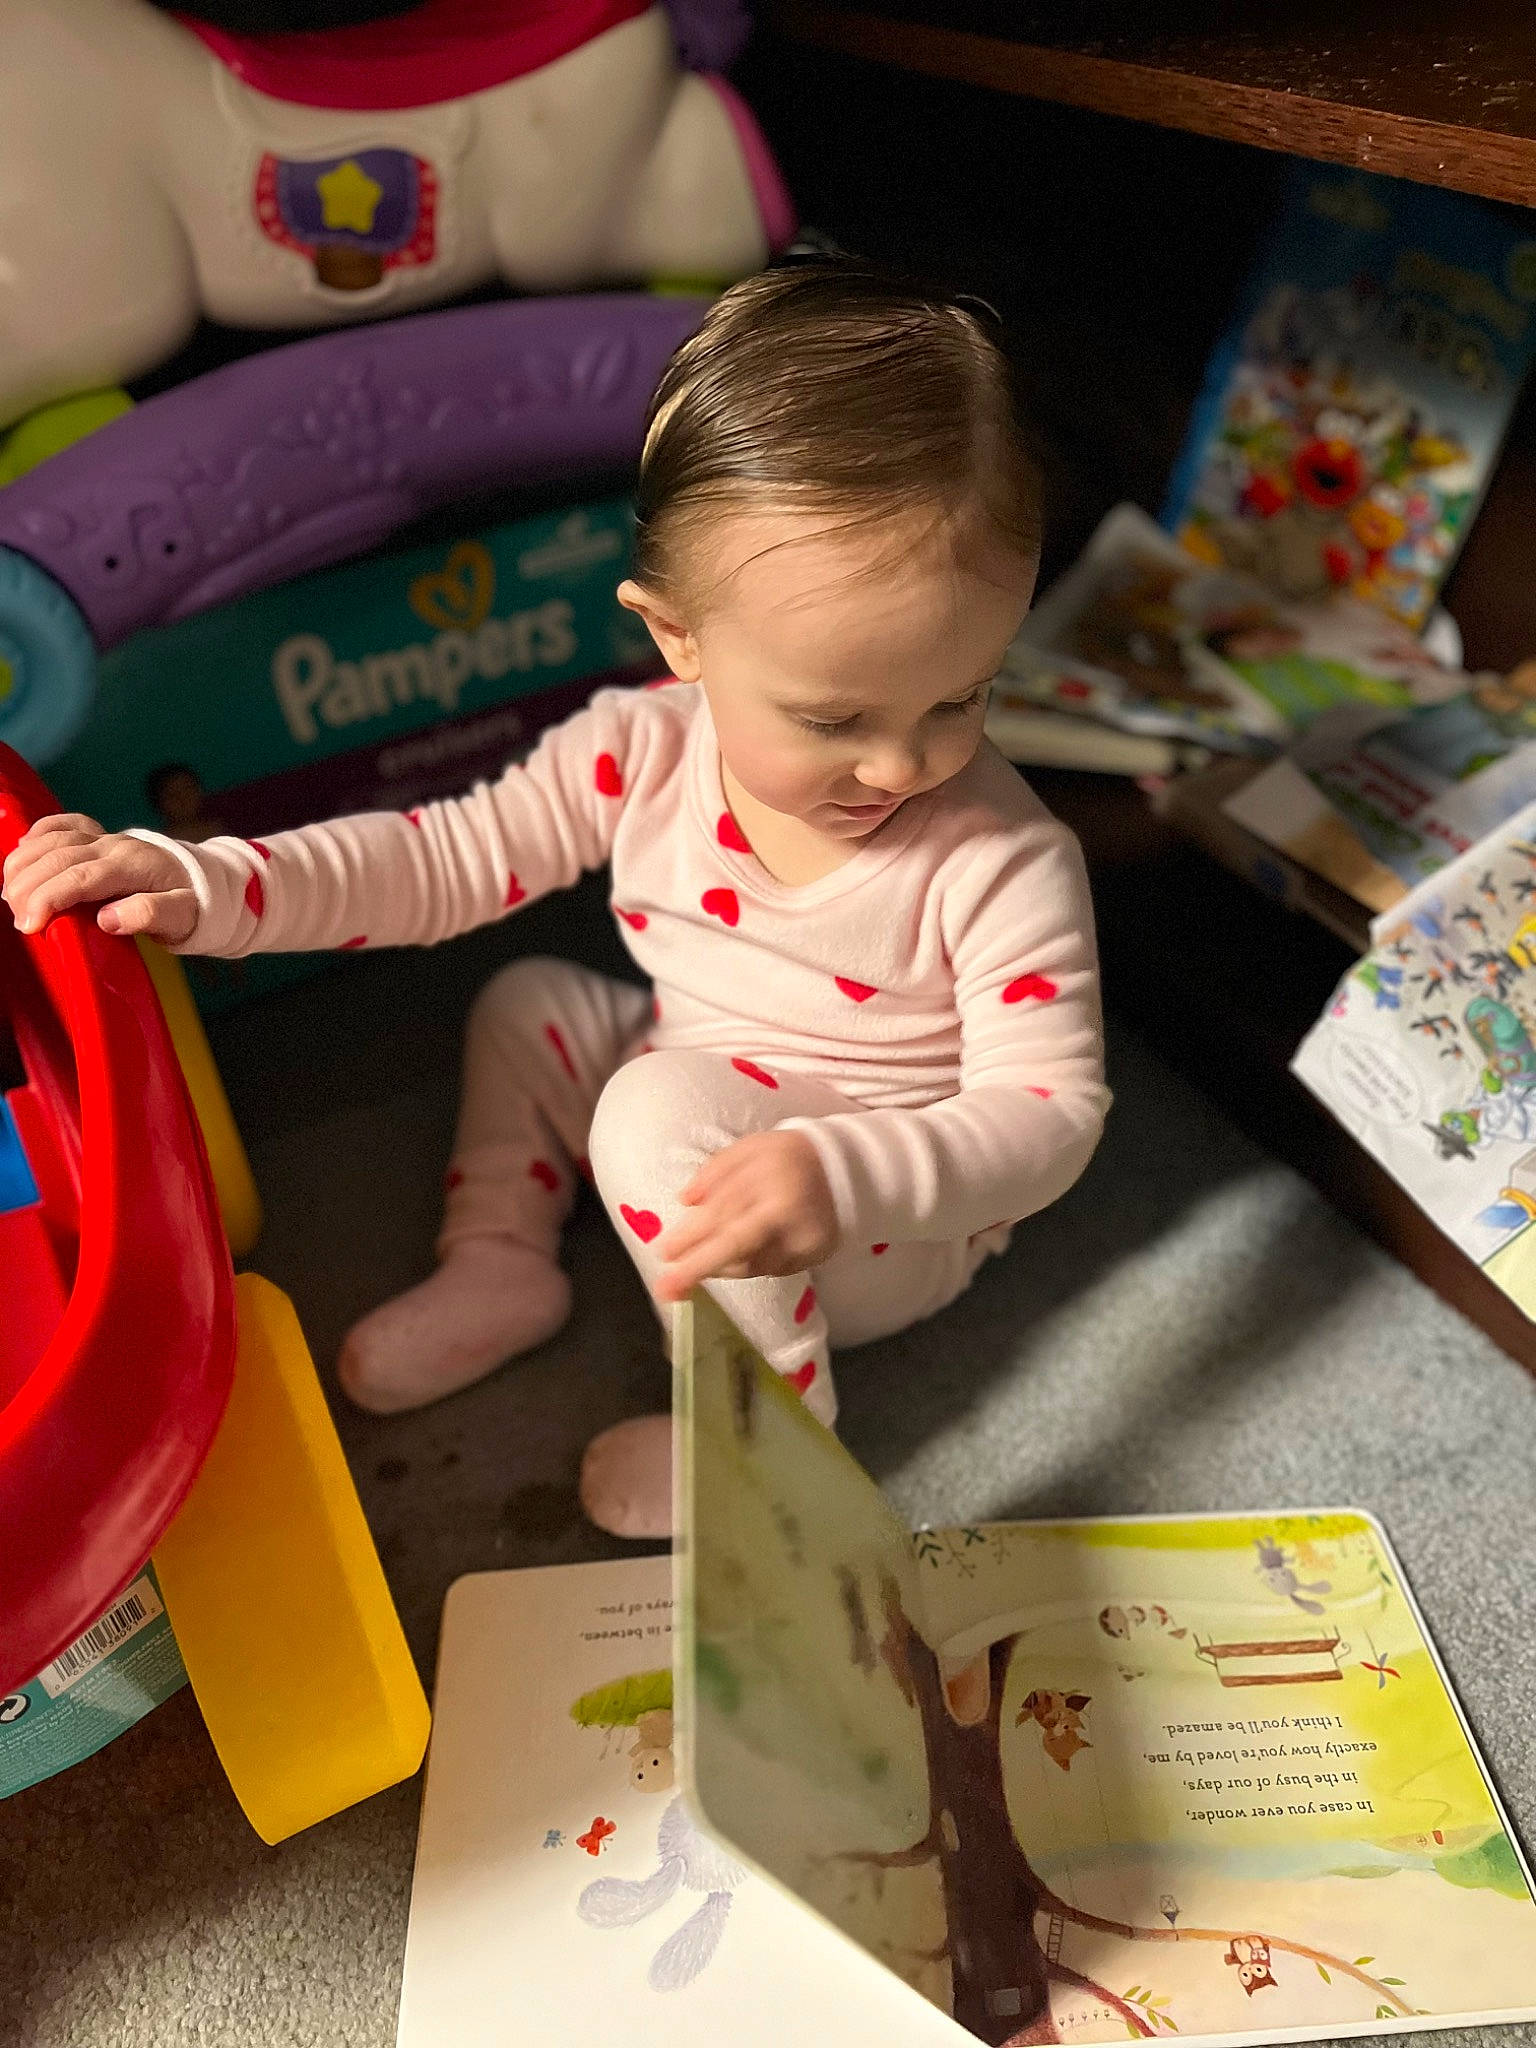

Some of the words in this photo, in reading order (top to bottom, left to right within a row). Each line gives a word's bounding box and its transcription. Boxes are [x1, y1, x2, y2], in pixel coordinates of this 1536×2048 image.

[273, 601, 577, 743] Pampers
[628, 1603, 643, 1616] of
[647, 1626, 660, 1636] in
[1227, 1722, 1247, 1734] be
[1249, 1716, 1290, 1734] you'll
[1292, 1717, 1332, 1731] think
[1334, 1716, 1343, 1728] I
[1161, 1722, 1224, 1738] amazed.
[1240, 1745, 1288, 1762] you're
[1291, 1746, 1320, 1758] how
[1325, 1742, 1378, 1757] exactly
[1143, 1754, 1171, 1765] me,
[1175, 1751, 1195, 1766] by
[1199, 1750, 1240, 1766] loved
[1227, 1778, 1252, 1788] our
[1275, 1774, 1313, 1788] busy
[1314, 1773, 1339, 1786] the
[1341, 1771, 1358, 1783] in
[1182, 1778, 1223, 1794] days,
[1256, 1777, 1271, 1792] of
[1251, 1806, 1284, 1816] ever
[1287, 1802, 1316, 1814] you
[1319, 1802, 1353, 1813] case
[1356, 1800, 1375, 1813] In
[1186, 1808, 1247, 1824] wonder,
